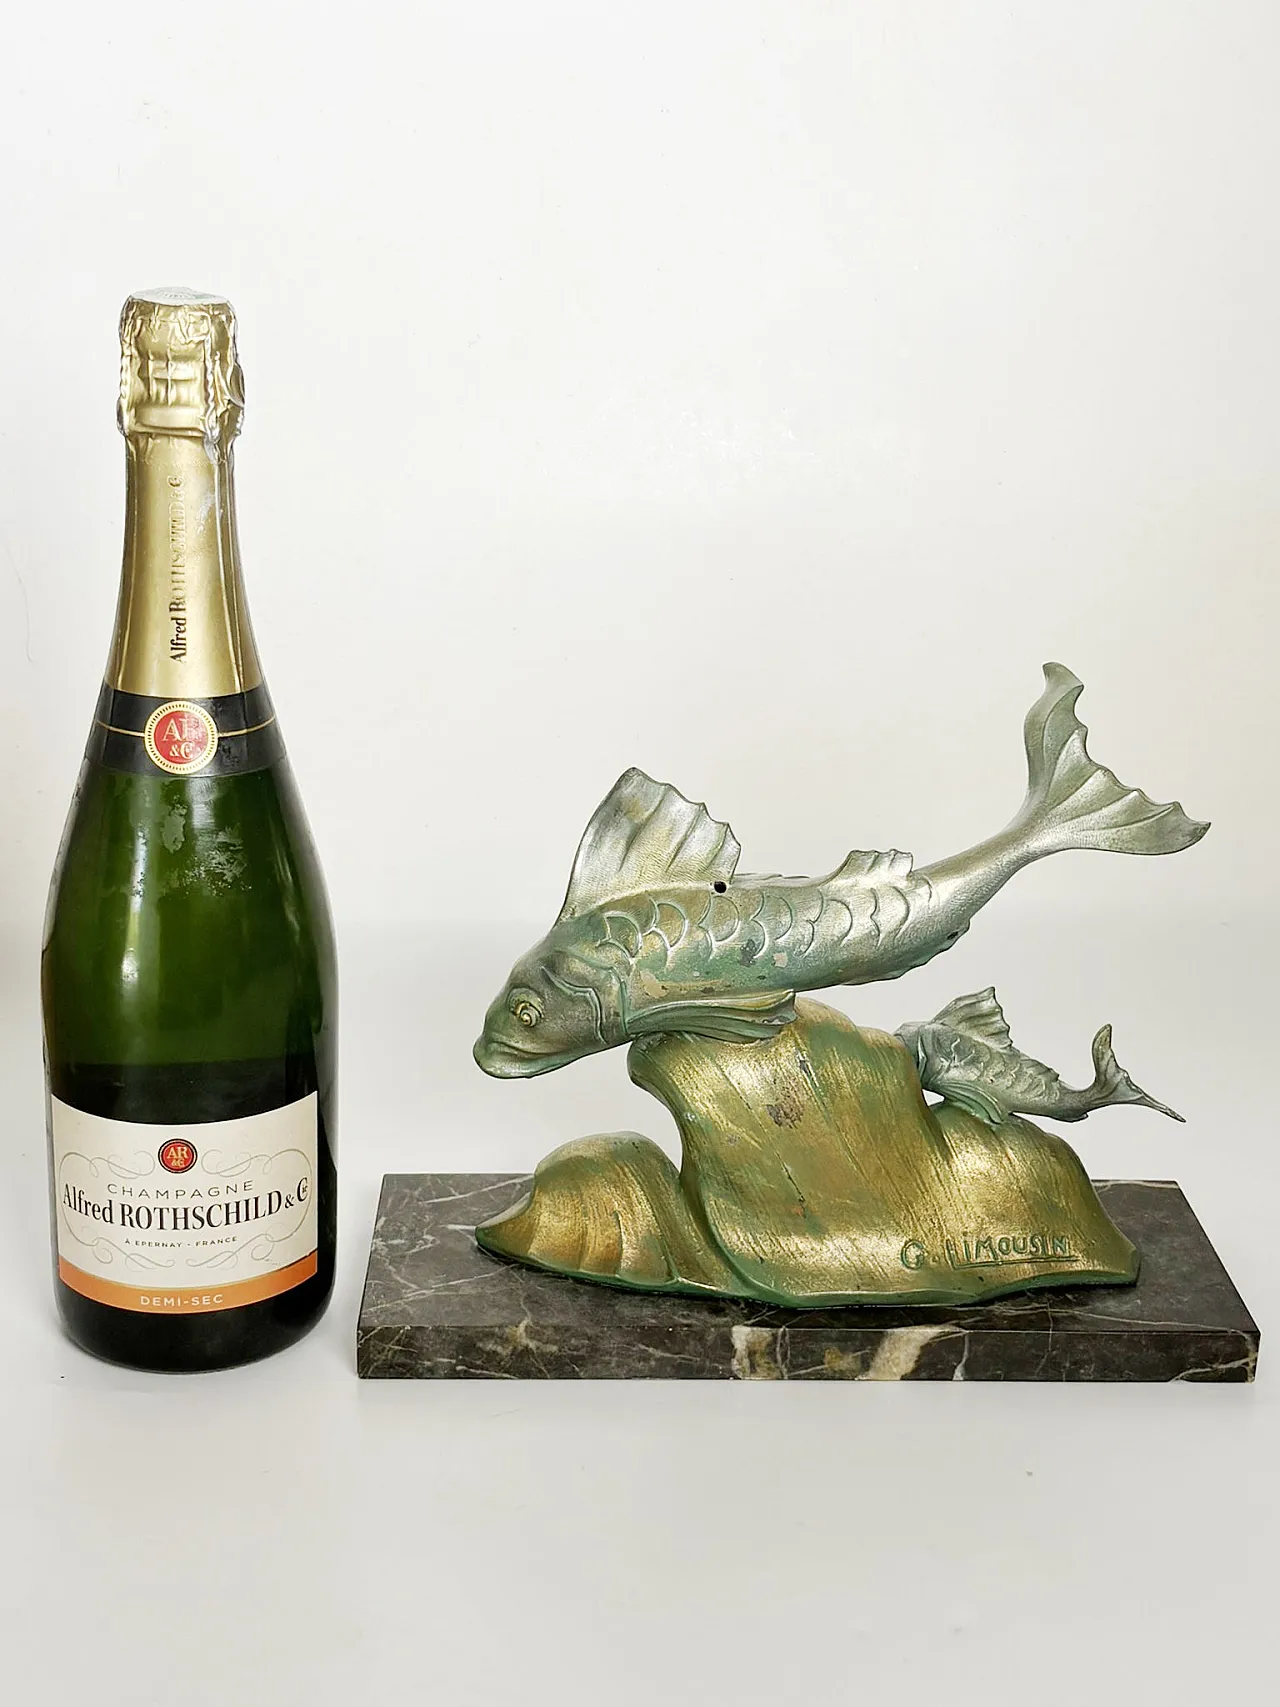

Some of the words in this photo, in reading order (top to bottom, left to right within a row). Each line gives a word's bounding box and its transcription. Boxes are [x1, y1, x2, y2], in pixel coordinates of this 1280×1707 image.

[169, 616, 188, 664] Alfred
[166, 1146, 189, 1159] AR
[107, 1180, 253, 1200] CHAMPAGNE
[63, 1183, 114, 1224] Alfred
[120, 1190, 281, 1231] ROTHSCHILD
[135, 1240, 182, 1248] EPERNAY
[195, 1236, 237, 1247] FRANCE
[945, 1233, 1076, 1270] LIMOUSIN
[140, 1294, 224, 1307] DEMI-SEC
